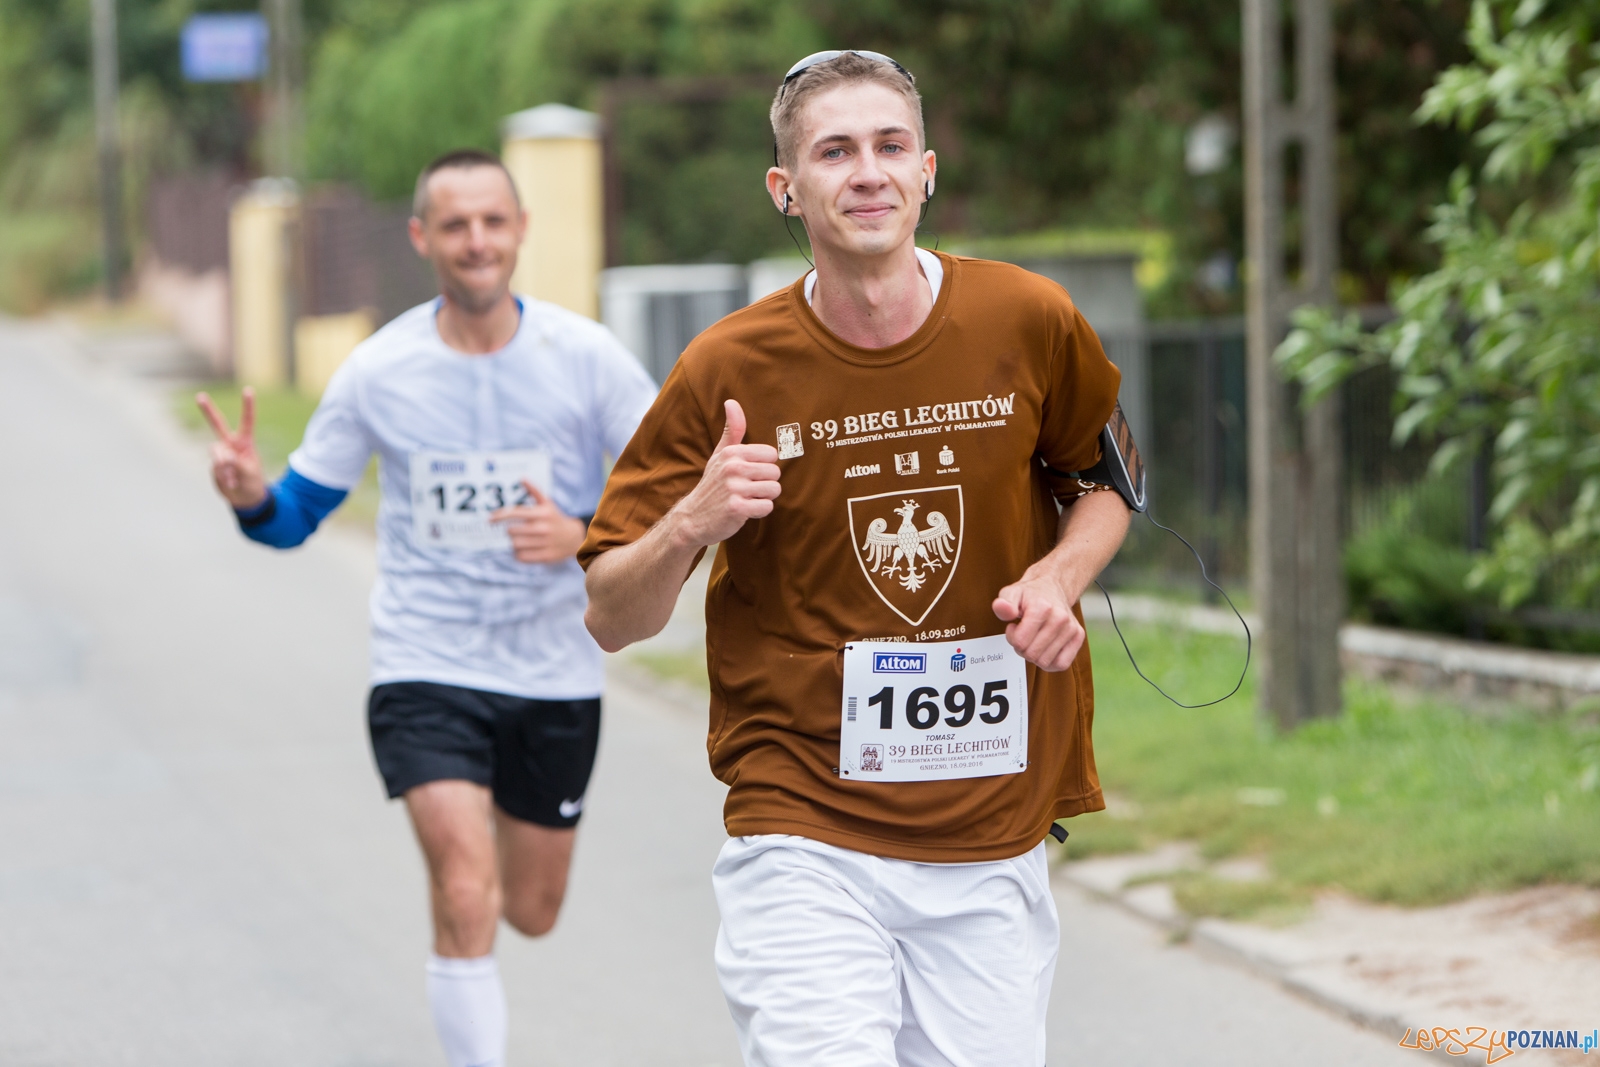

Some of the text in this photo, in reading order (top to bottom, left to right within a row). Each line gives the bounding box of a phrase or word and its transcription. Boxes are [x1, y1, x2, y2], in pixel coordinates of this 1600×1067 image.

[811, 392, 1016, 440] 39 BIEG LECHITÓW
[826, 418, 1007, 449] 19 MISTRZOSTWA POLSKI LEKARZY W PÓŁMARATONIE
[430, 483, 531, 512] 1232
[915, 625, 966, 642] 18.09.2016
[970, 656, 985, 665] Bank
[986, 653, 1004, 663] Polski
[868, 679, 1010, 731] 1695
[888, 735, 1011, 757] 39 BIEG LECHITÓW
[925, 733, 956, 741] TOMASZ
[950, 761, 984, 769] 18.09.2016
